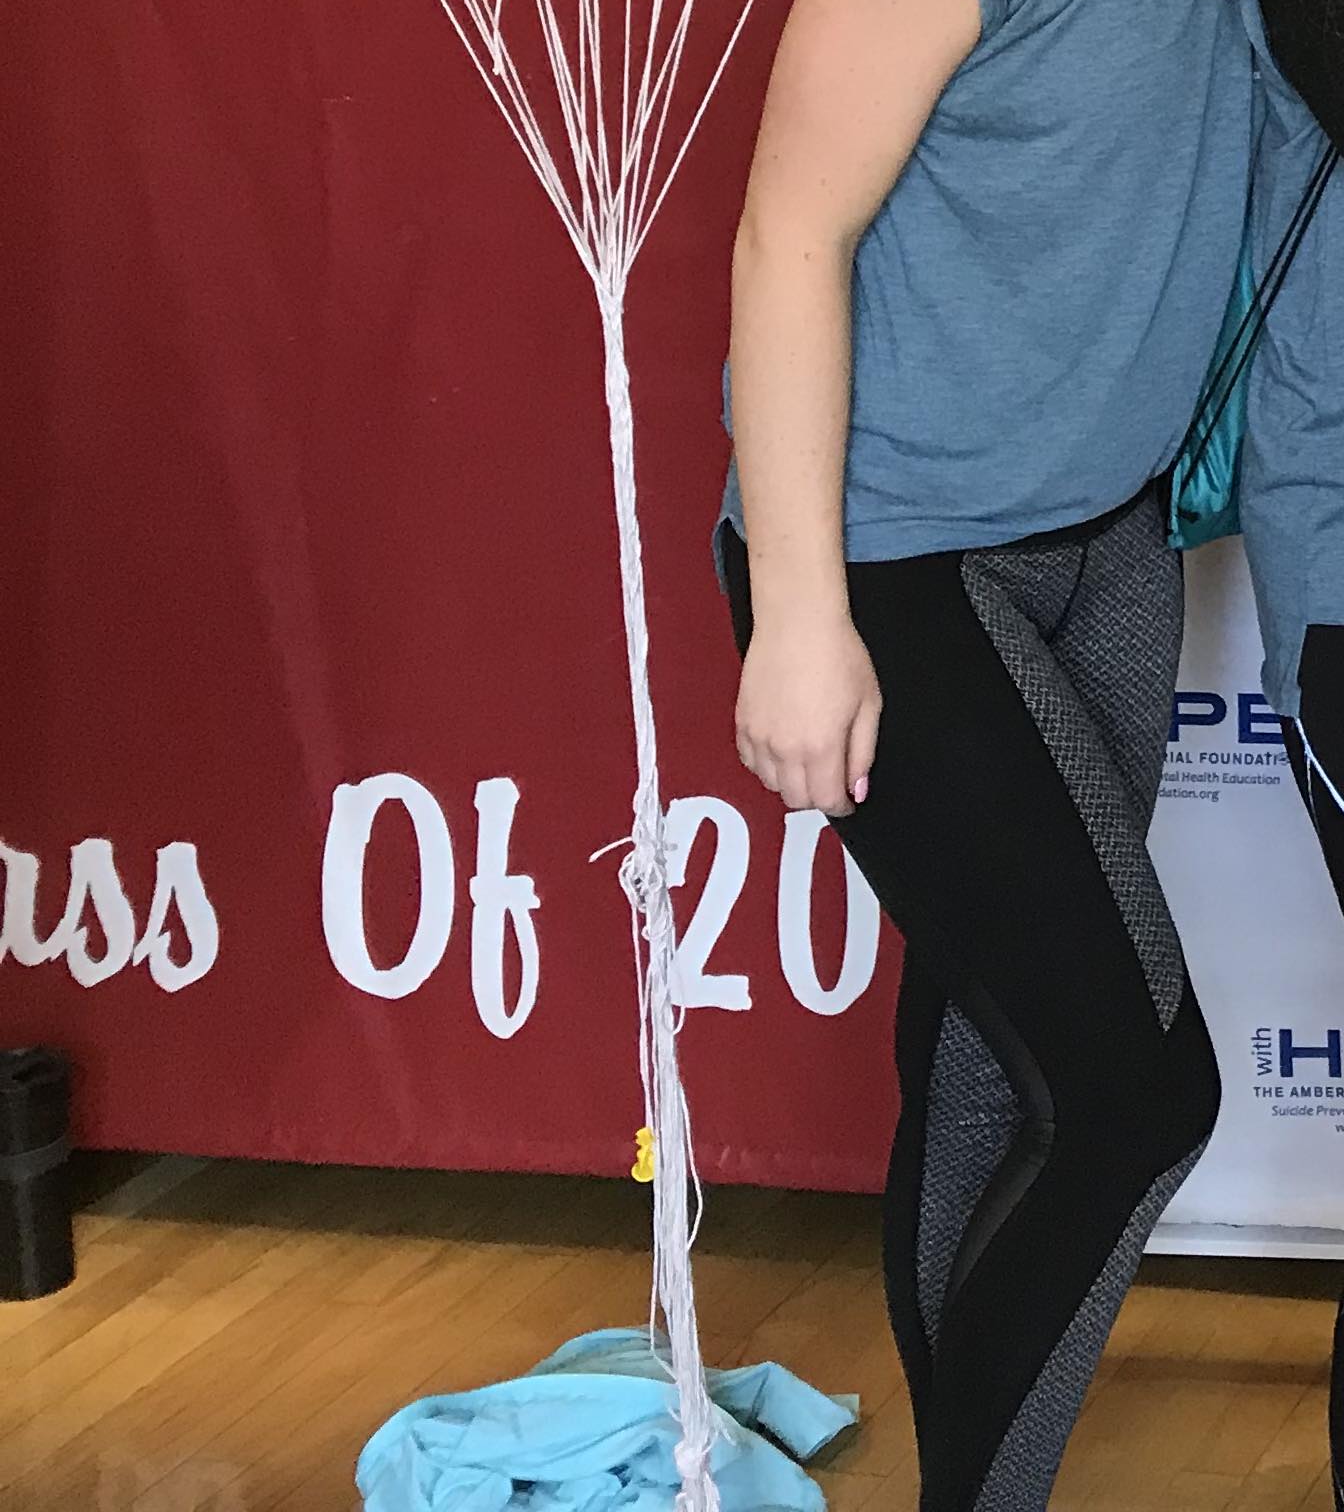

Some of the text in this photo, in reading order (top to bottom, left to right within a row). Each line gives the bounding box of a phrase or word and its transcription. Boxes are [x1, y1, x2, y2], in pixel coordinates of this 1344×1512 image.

[322, 772, 540, 1038] Of
[1251, 1027, 1272, 1076] with
[1253, 1086, 1284, 1098] THE
[1290, 1086, 1344, 1099] AMBER
[1272, 1105, 1314, 1117] Suicide
